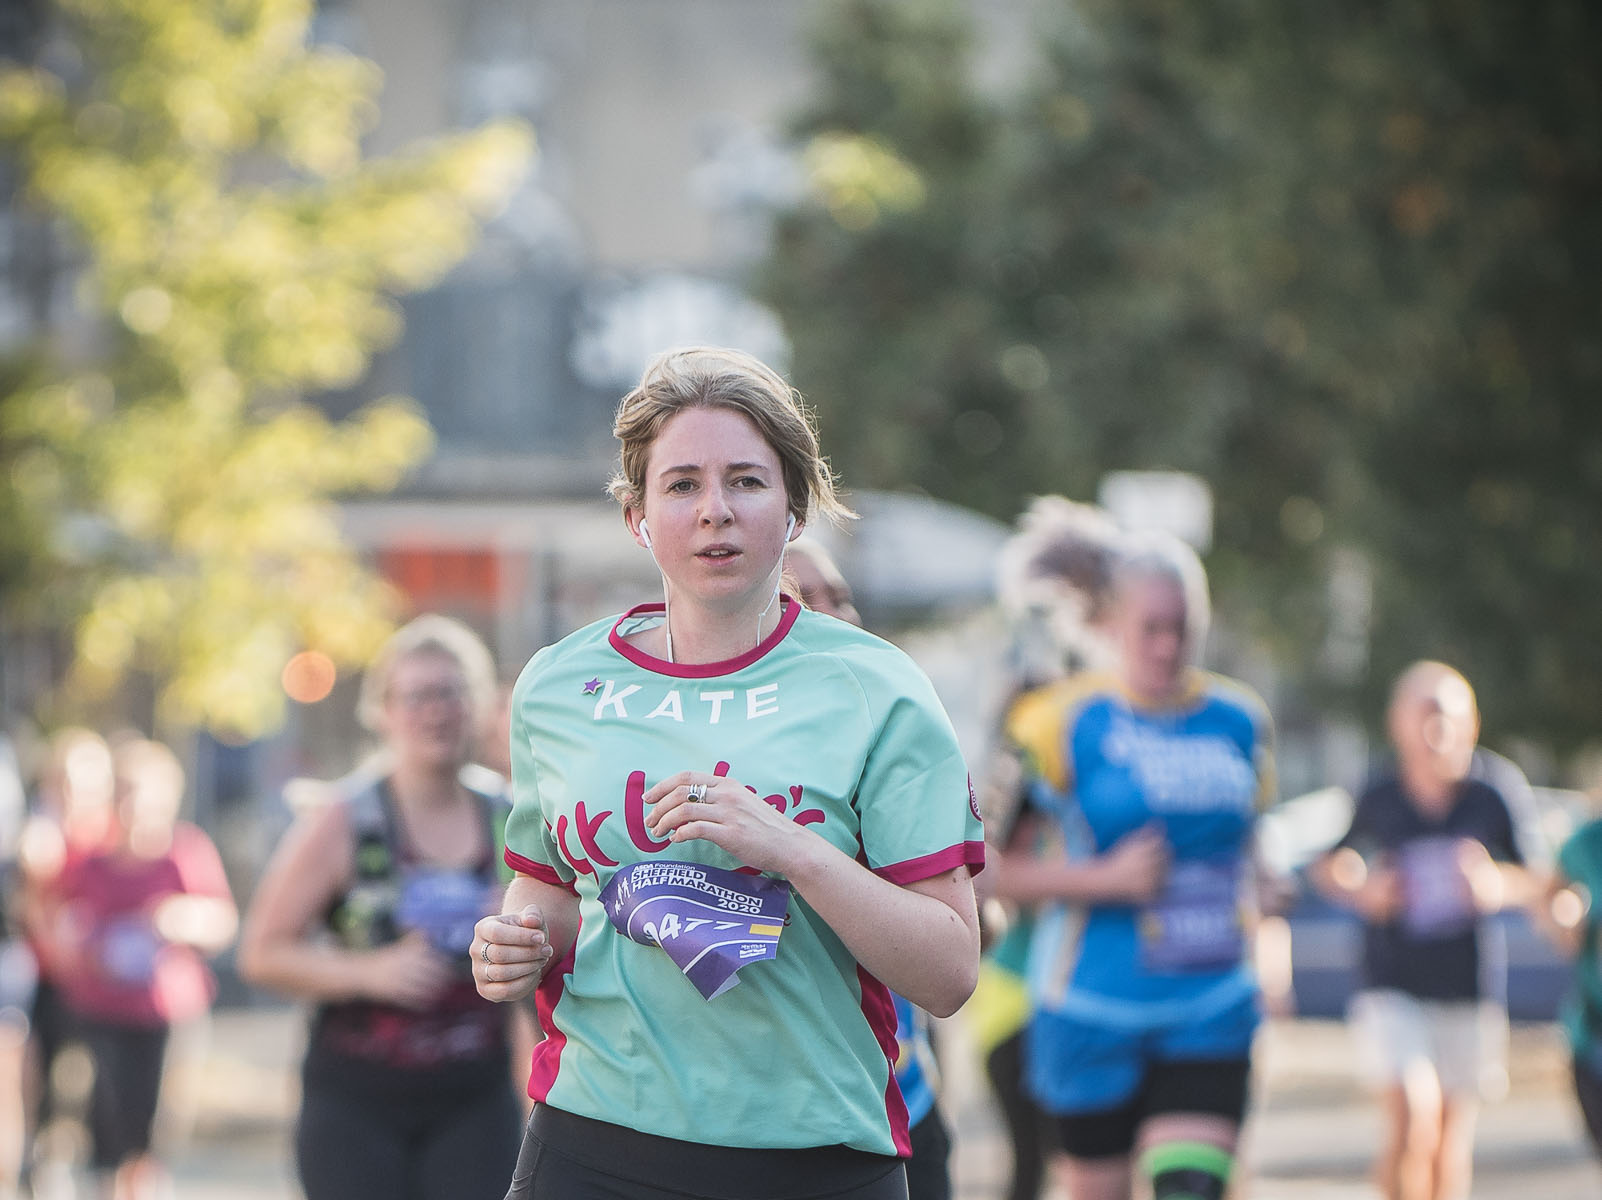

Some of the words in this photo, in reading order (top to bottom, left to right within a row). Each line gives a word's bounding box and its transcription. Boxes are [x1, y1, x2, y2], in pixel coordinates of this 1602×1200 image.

[593, 680, 779, 723] KATE
[633, 868, 704, 880] SHEFFIELD
[632, 877, 668, 893] HALF
[671, 878, 760, 905] MARATHON
[718, 899, 761, 914] 2020
